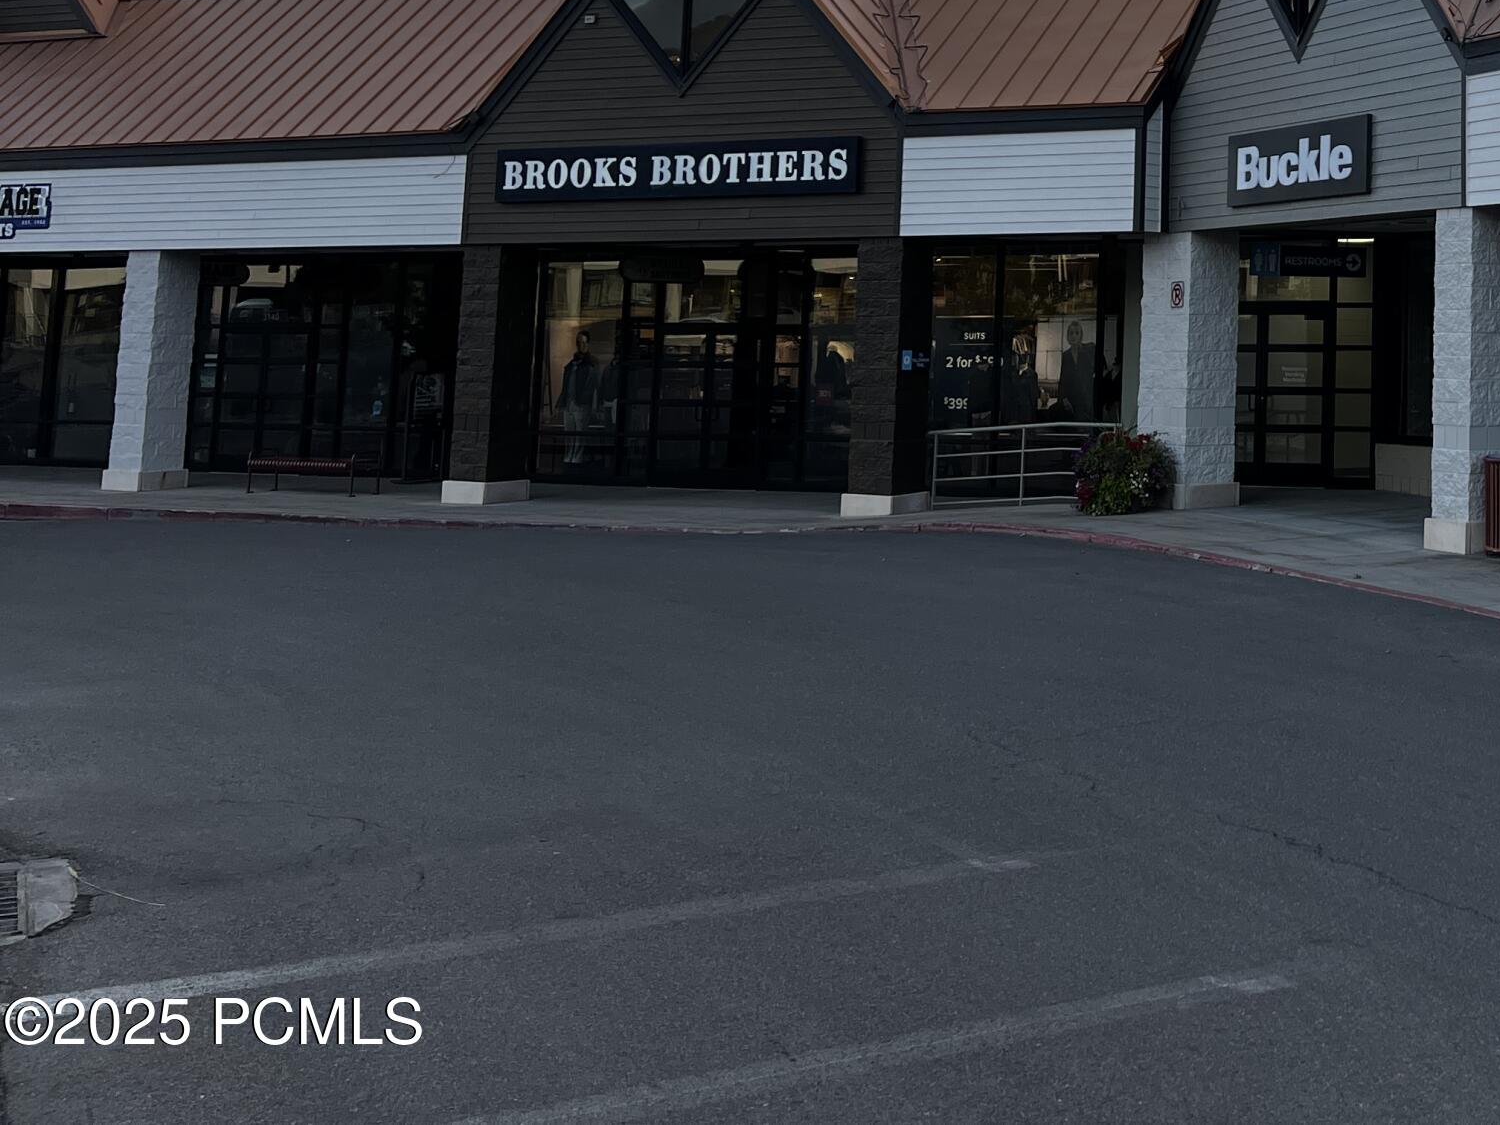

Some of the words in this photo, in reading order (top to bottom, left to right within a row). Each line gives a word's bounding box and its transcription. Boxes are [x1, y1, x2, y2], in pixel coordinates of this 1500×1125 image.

[1236, 134, 1353, 191] Buckle
[502, 156, 637, 191] BROOKS
[650, 148, 848, 186] BROTHERS
[1284, 255, 1343, 268] RESTROOMS
[963, 332, 986, 340] SUITS
[945, 356, 954, 368] 2
[956, 355, 973, 368] for
